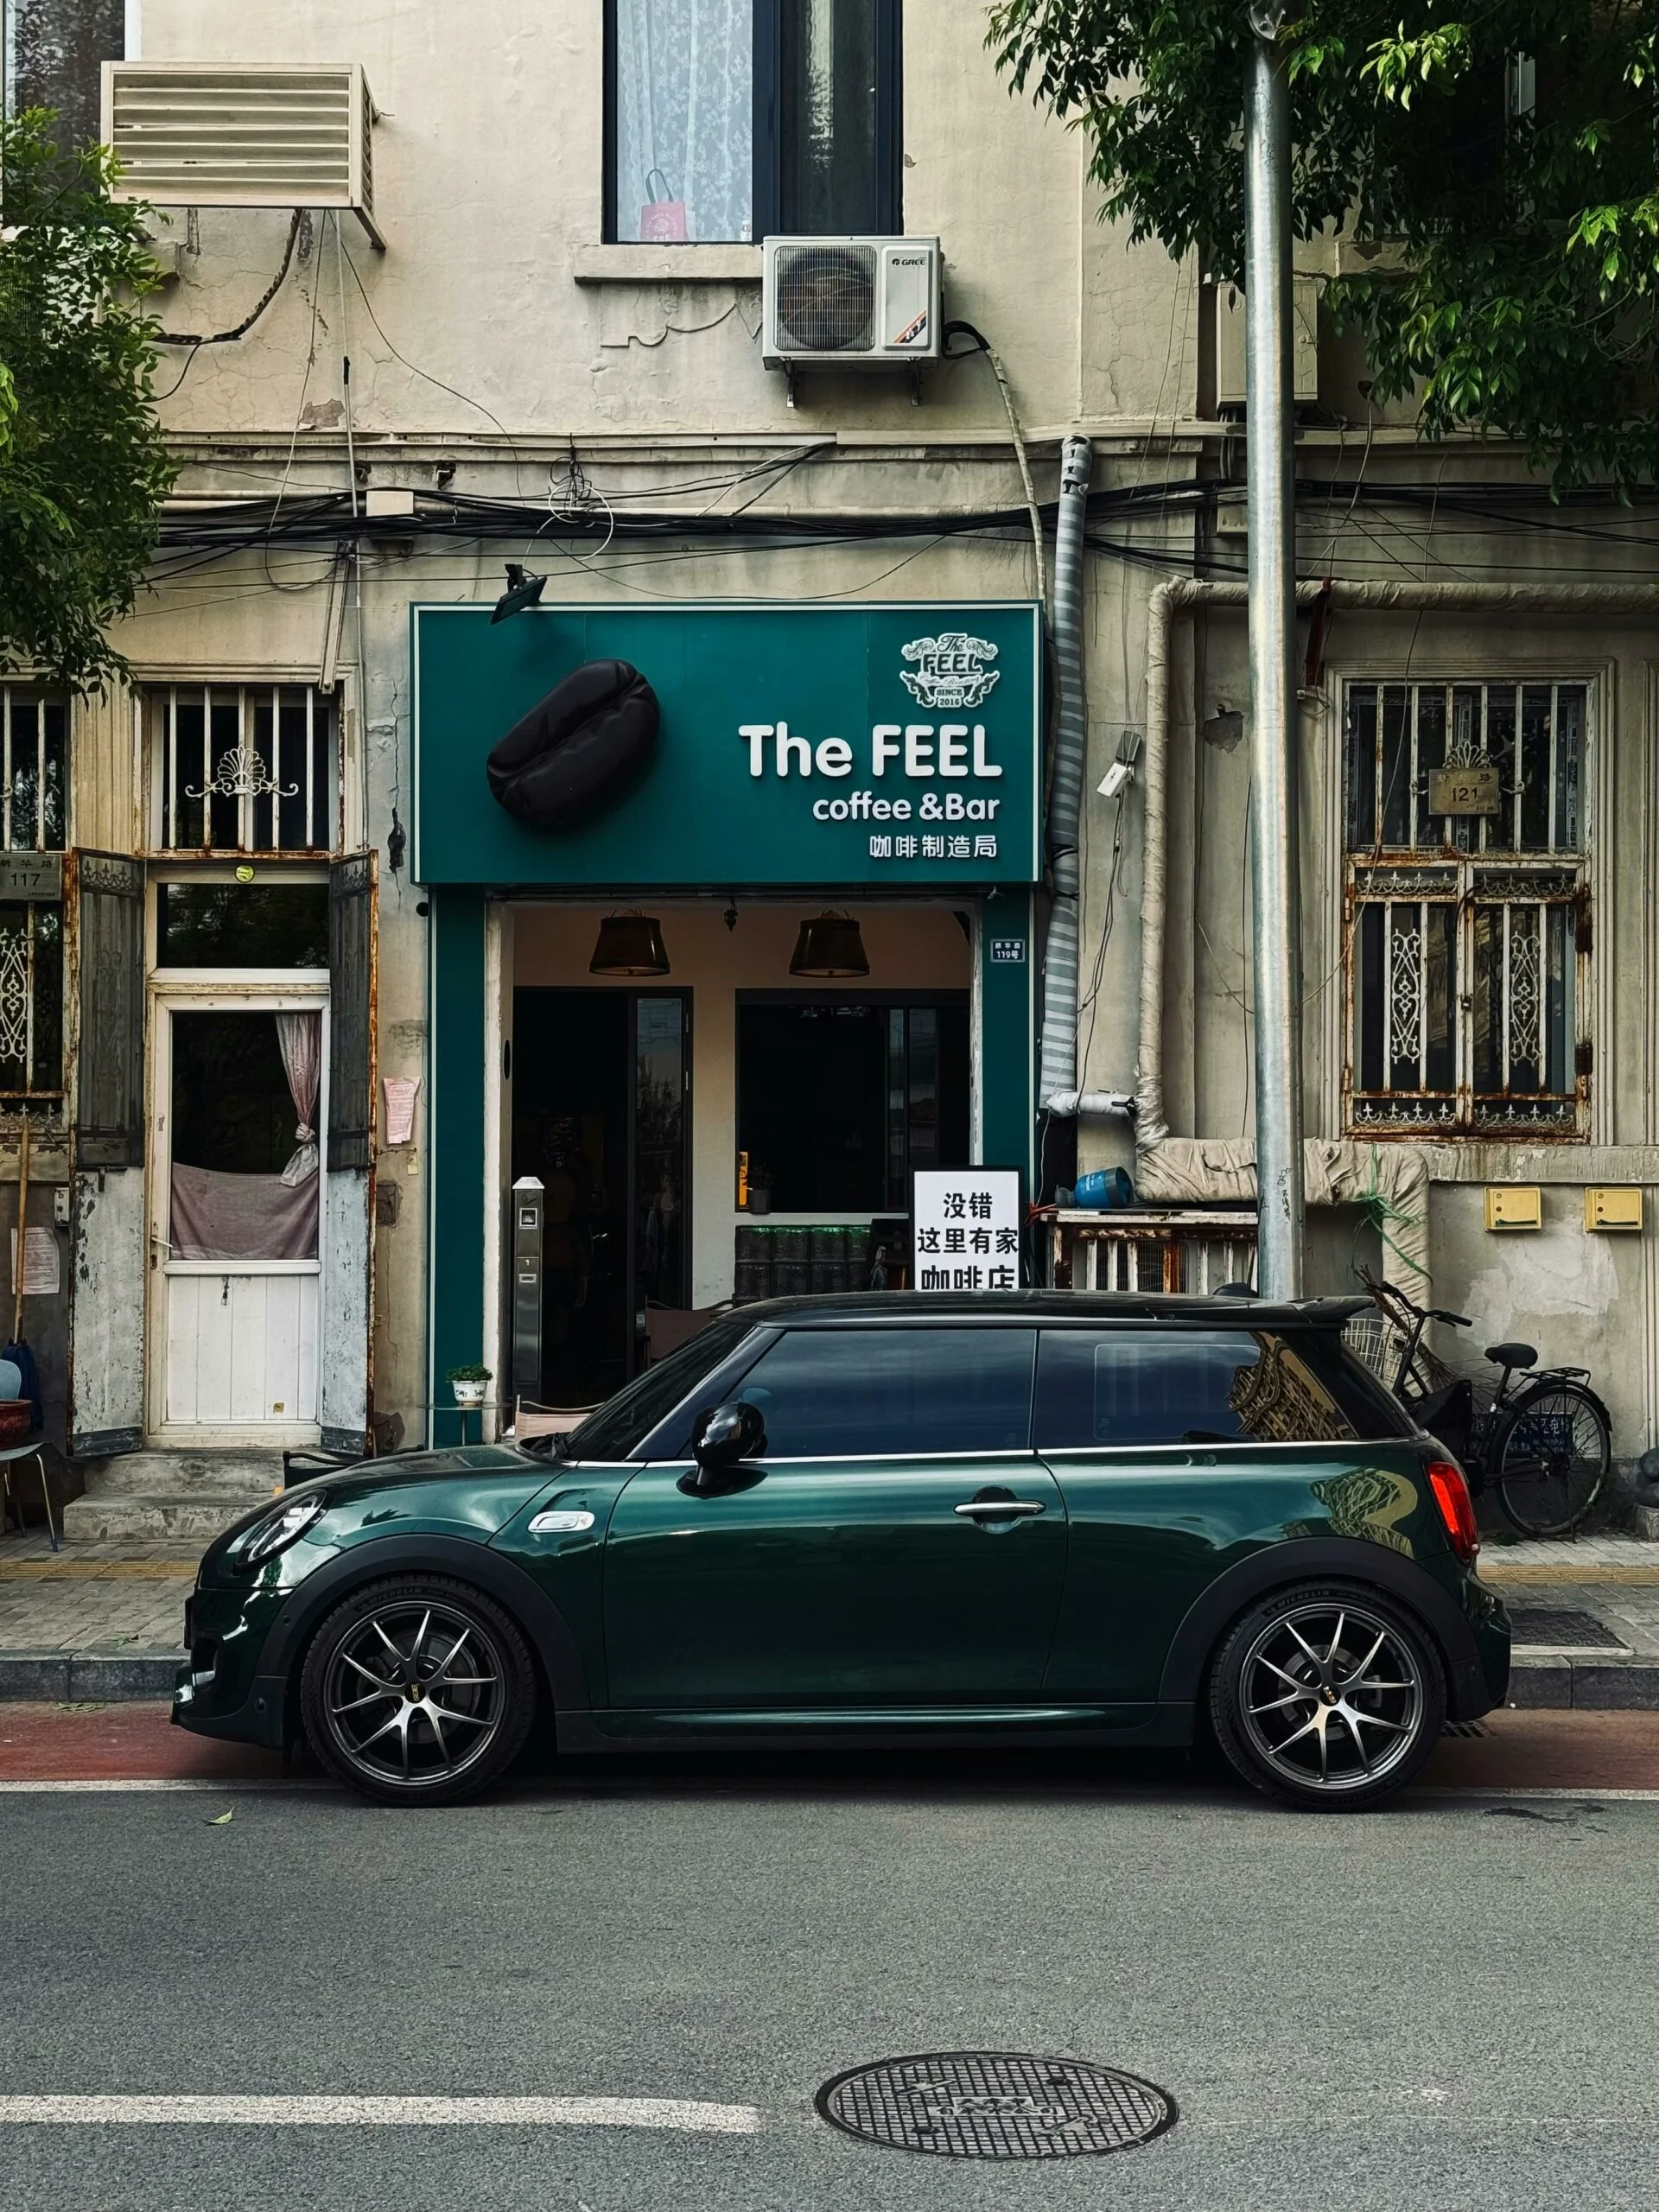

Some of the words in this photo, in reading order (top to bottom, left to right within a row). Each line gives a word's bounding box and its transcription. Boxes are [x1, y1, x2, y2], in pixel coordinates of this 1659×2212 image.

[901, 257, 927, 266] GREE
[937, 634, 966, 652] The
[923, 653, 982, 672] FEEL
[738, 721, 853, 777] The
[872, 724, 1003, 777] FEEL
[812, 791, 912, 820] coffee
[918, 792, 1000, 820] &Bar
[1452, 787, 1478, 802] 121
[868, 835, 997, 858] 咖啡制造局
[10, 873, 41, 887] 117
[943, 1192, 993, 1219] 没错
[917, 1227, 1020, 1255] 这里有家
[921, 1264, 1015, 1290] 咖啡店
